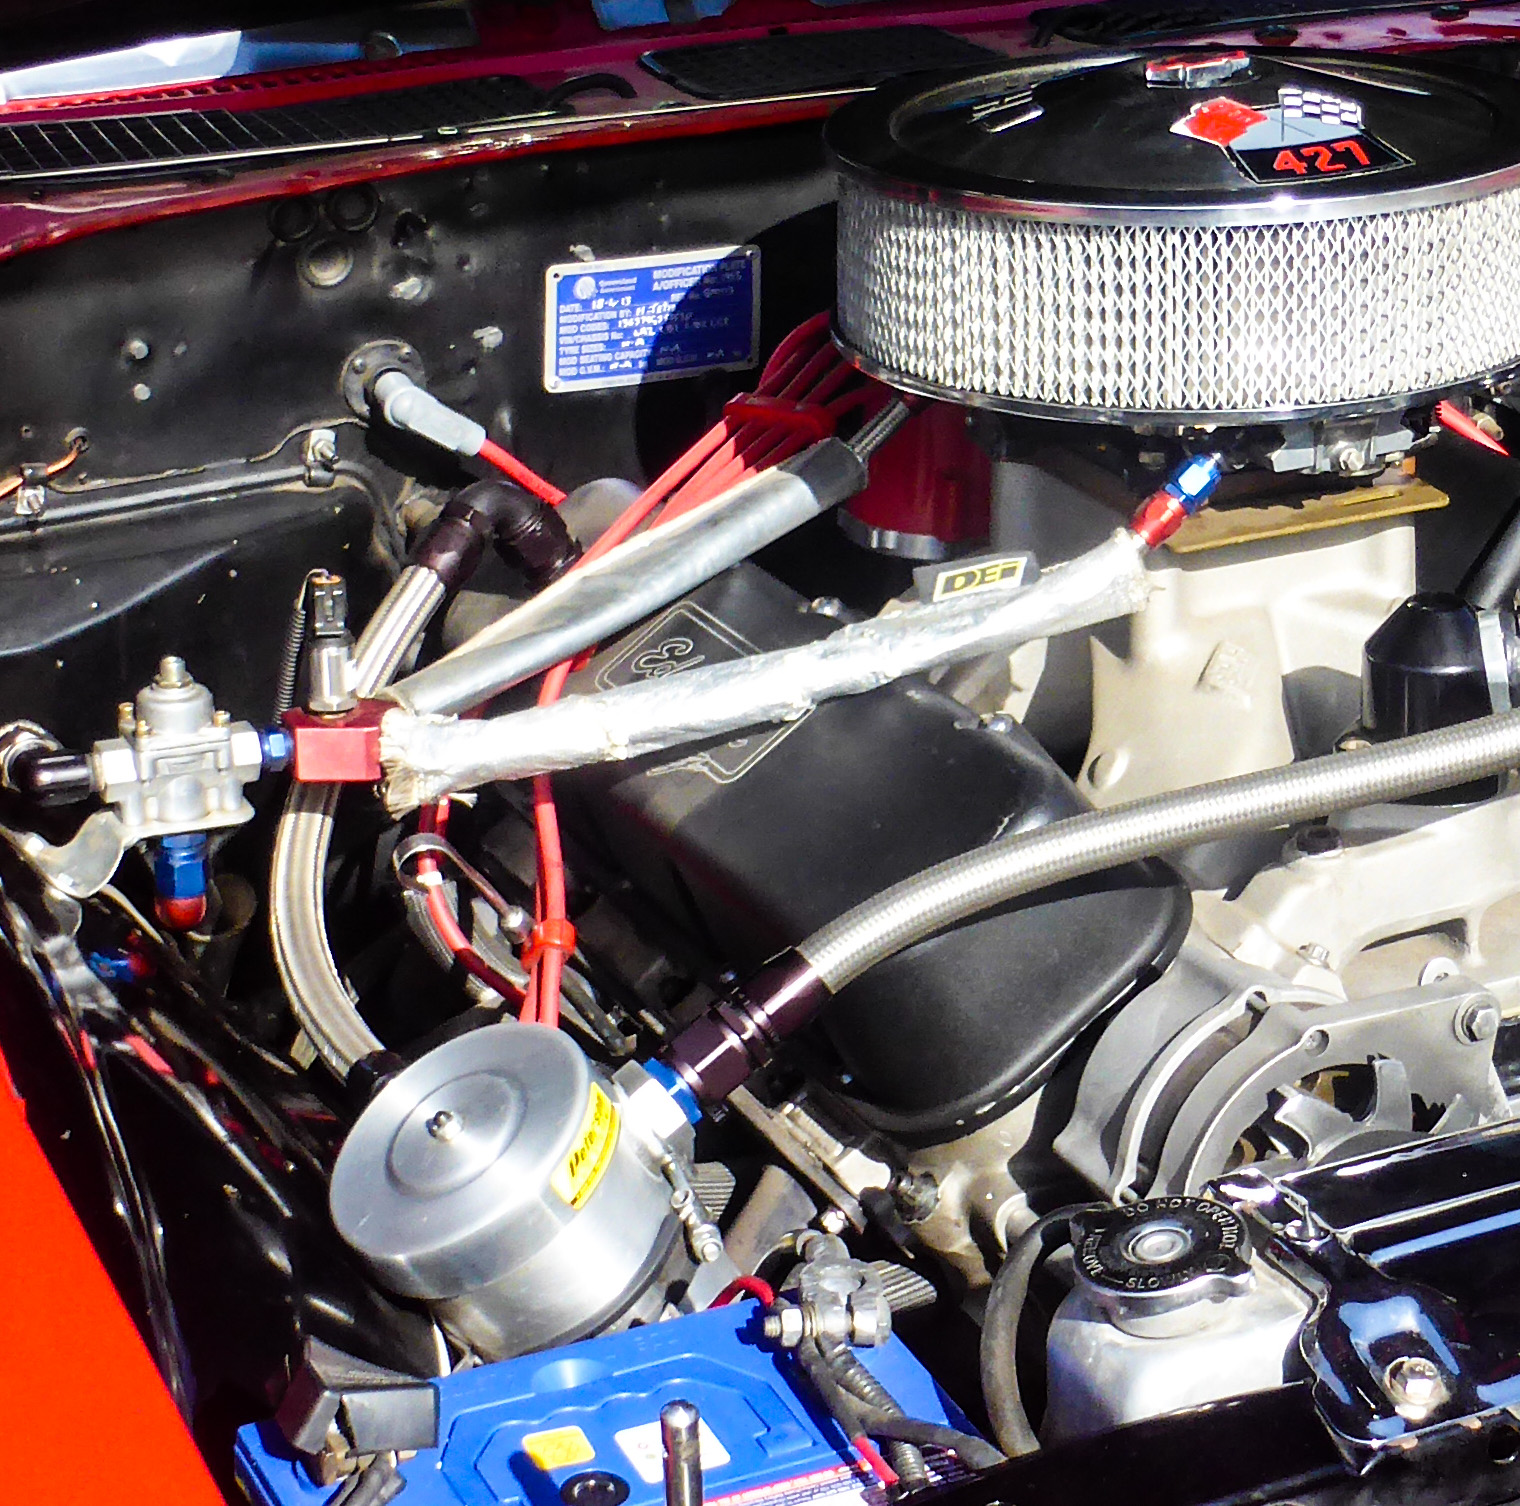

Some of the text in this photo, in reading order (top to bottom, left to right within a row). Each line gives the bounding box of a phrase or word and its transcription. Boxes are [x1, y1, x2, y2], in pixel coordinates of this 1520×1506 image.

[1272, 139, 1371, 175] 427
[653, 263, 718, 279] MODIFICATION
[558, 304, 583, 314] DATE:
[558, 310, 618, 324] MODIFICATION
[1155, 1199, 1196, 1210] NOT
